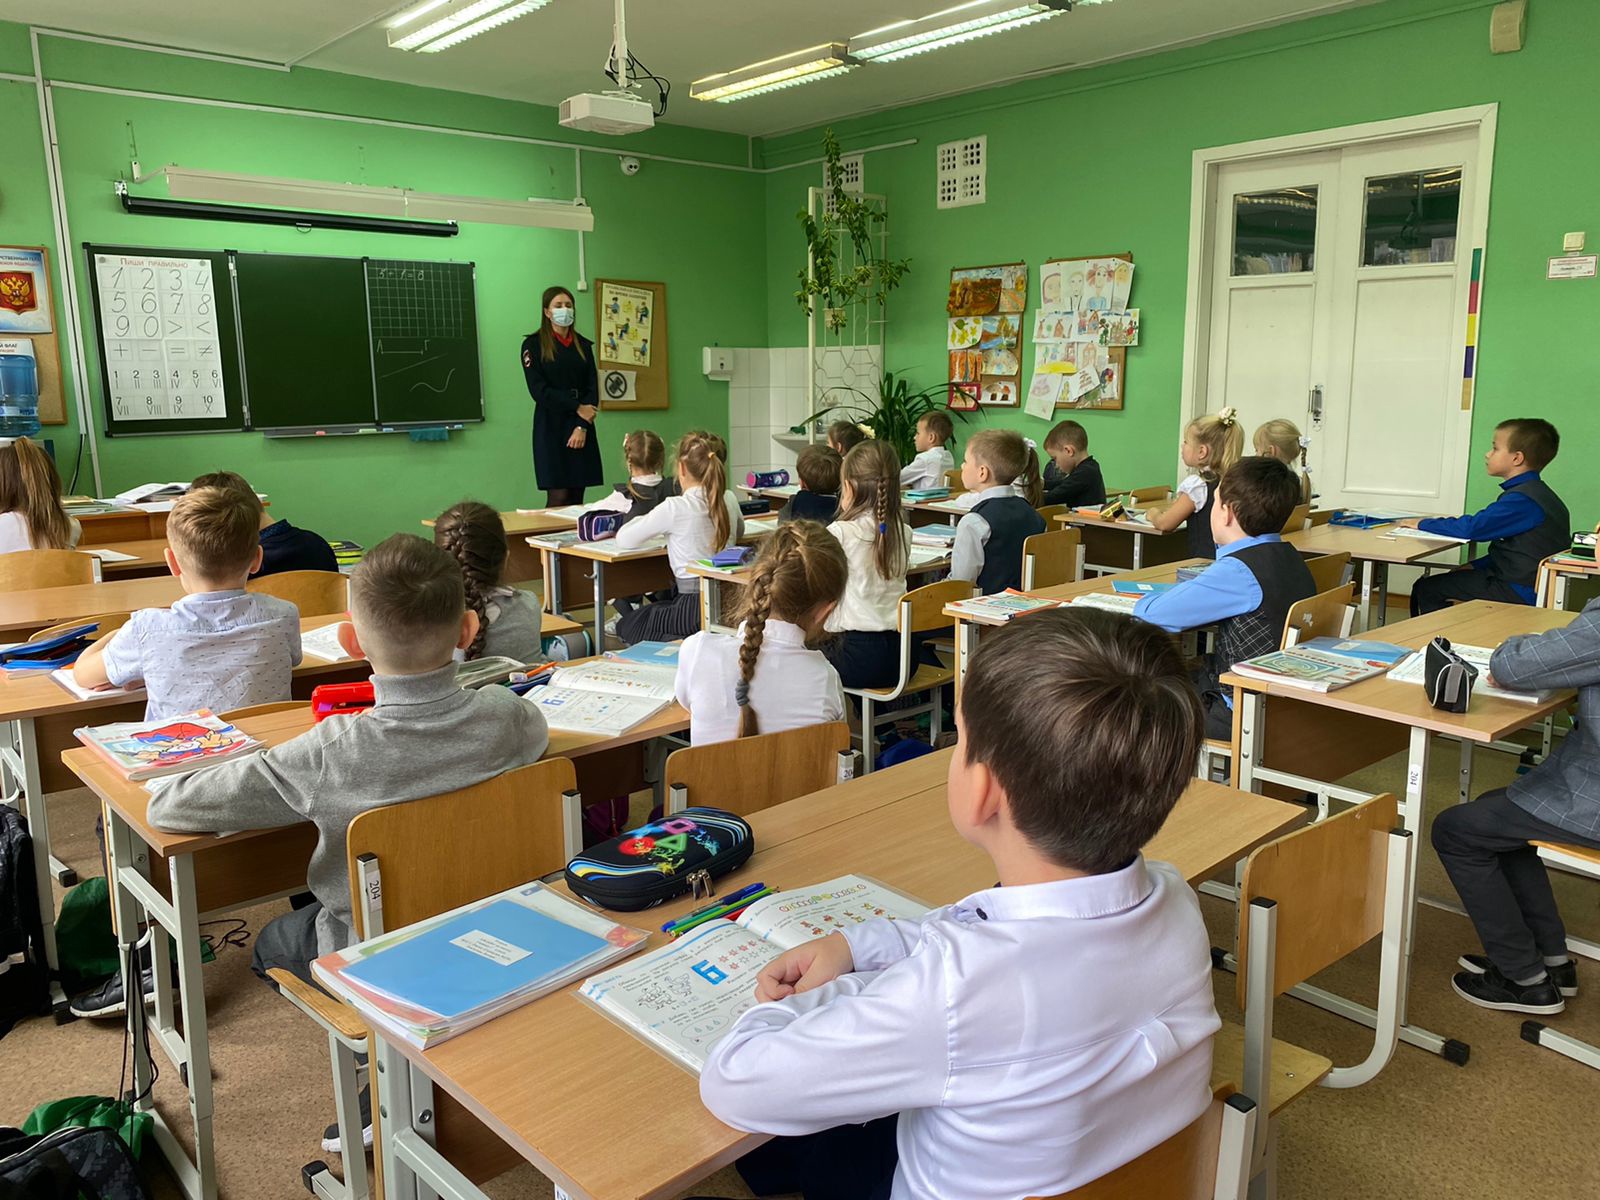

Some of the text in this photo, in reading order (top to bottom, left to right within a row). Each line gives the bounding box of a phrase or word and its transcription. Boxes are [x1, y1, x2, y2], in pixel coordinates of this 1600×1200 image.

[112, 267, 209, 291] 1 2 3 4
[112, 292, 211, 315] 5 6 7 8
[115, 315, 210, 337] 9 0 > <
[114, 370, 218, 379] 1 2 3 4 5 6
[115, 395, 213, 405] 7 8 9 10
[369, 880, 381, 900] 204
[690, 959, 729, 986] 6
